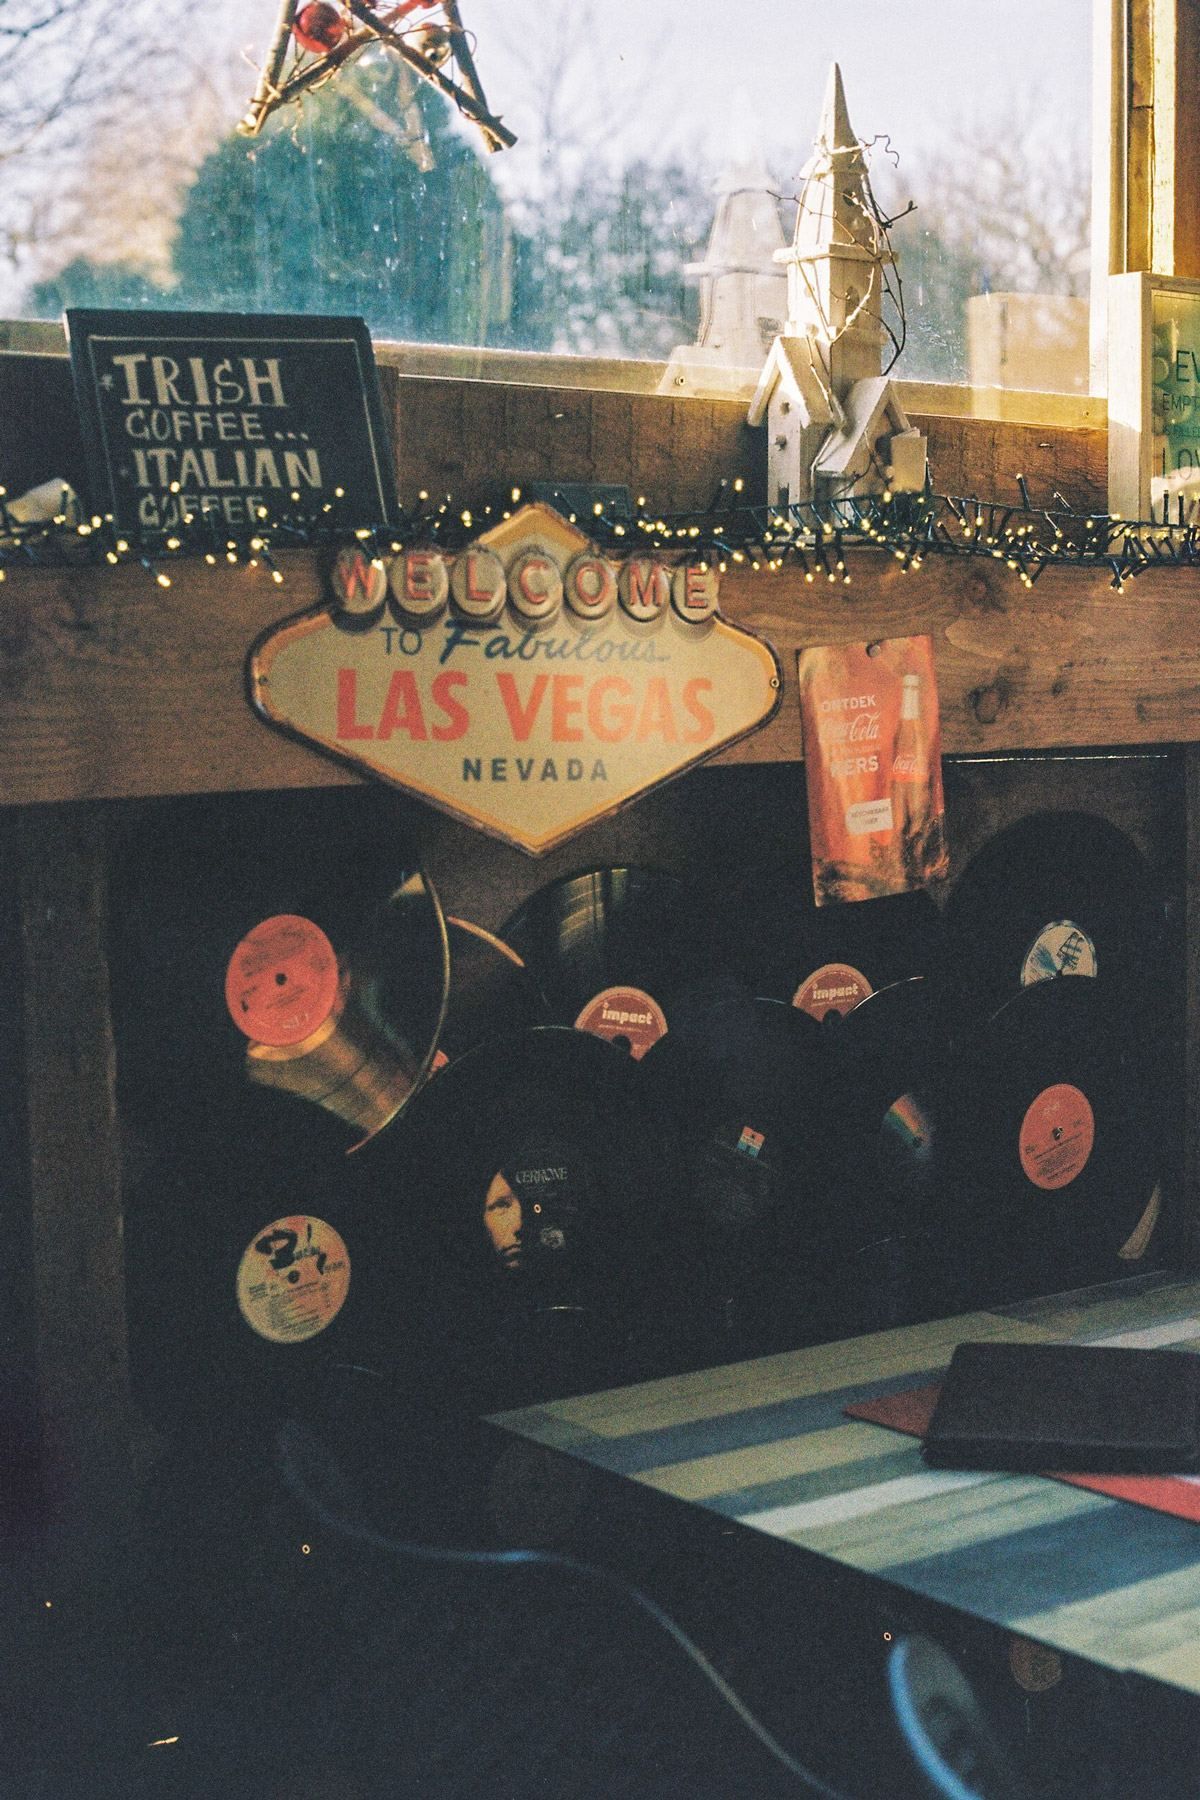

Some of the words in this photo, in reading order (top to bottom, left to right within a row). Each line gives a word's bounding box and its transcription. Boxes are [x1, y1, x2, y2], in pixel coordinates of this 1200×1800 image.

[113, 353, 288, 408] IRISH
[132, 448, 323, 489] ITALIAN
[339, 552, 709, 609] WELCOME
[379, 627, 424, 656] TO
[439, 618, 671, 664] Fabulous
[336, 667, 471, 742] LAS
[496, 671, 717, 744] VEGAS
[462, 756, 608, 783] NEVADA
[602, 1000, 653, 1025] impact
[812, 982, 859, 1001] impact
